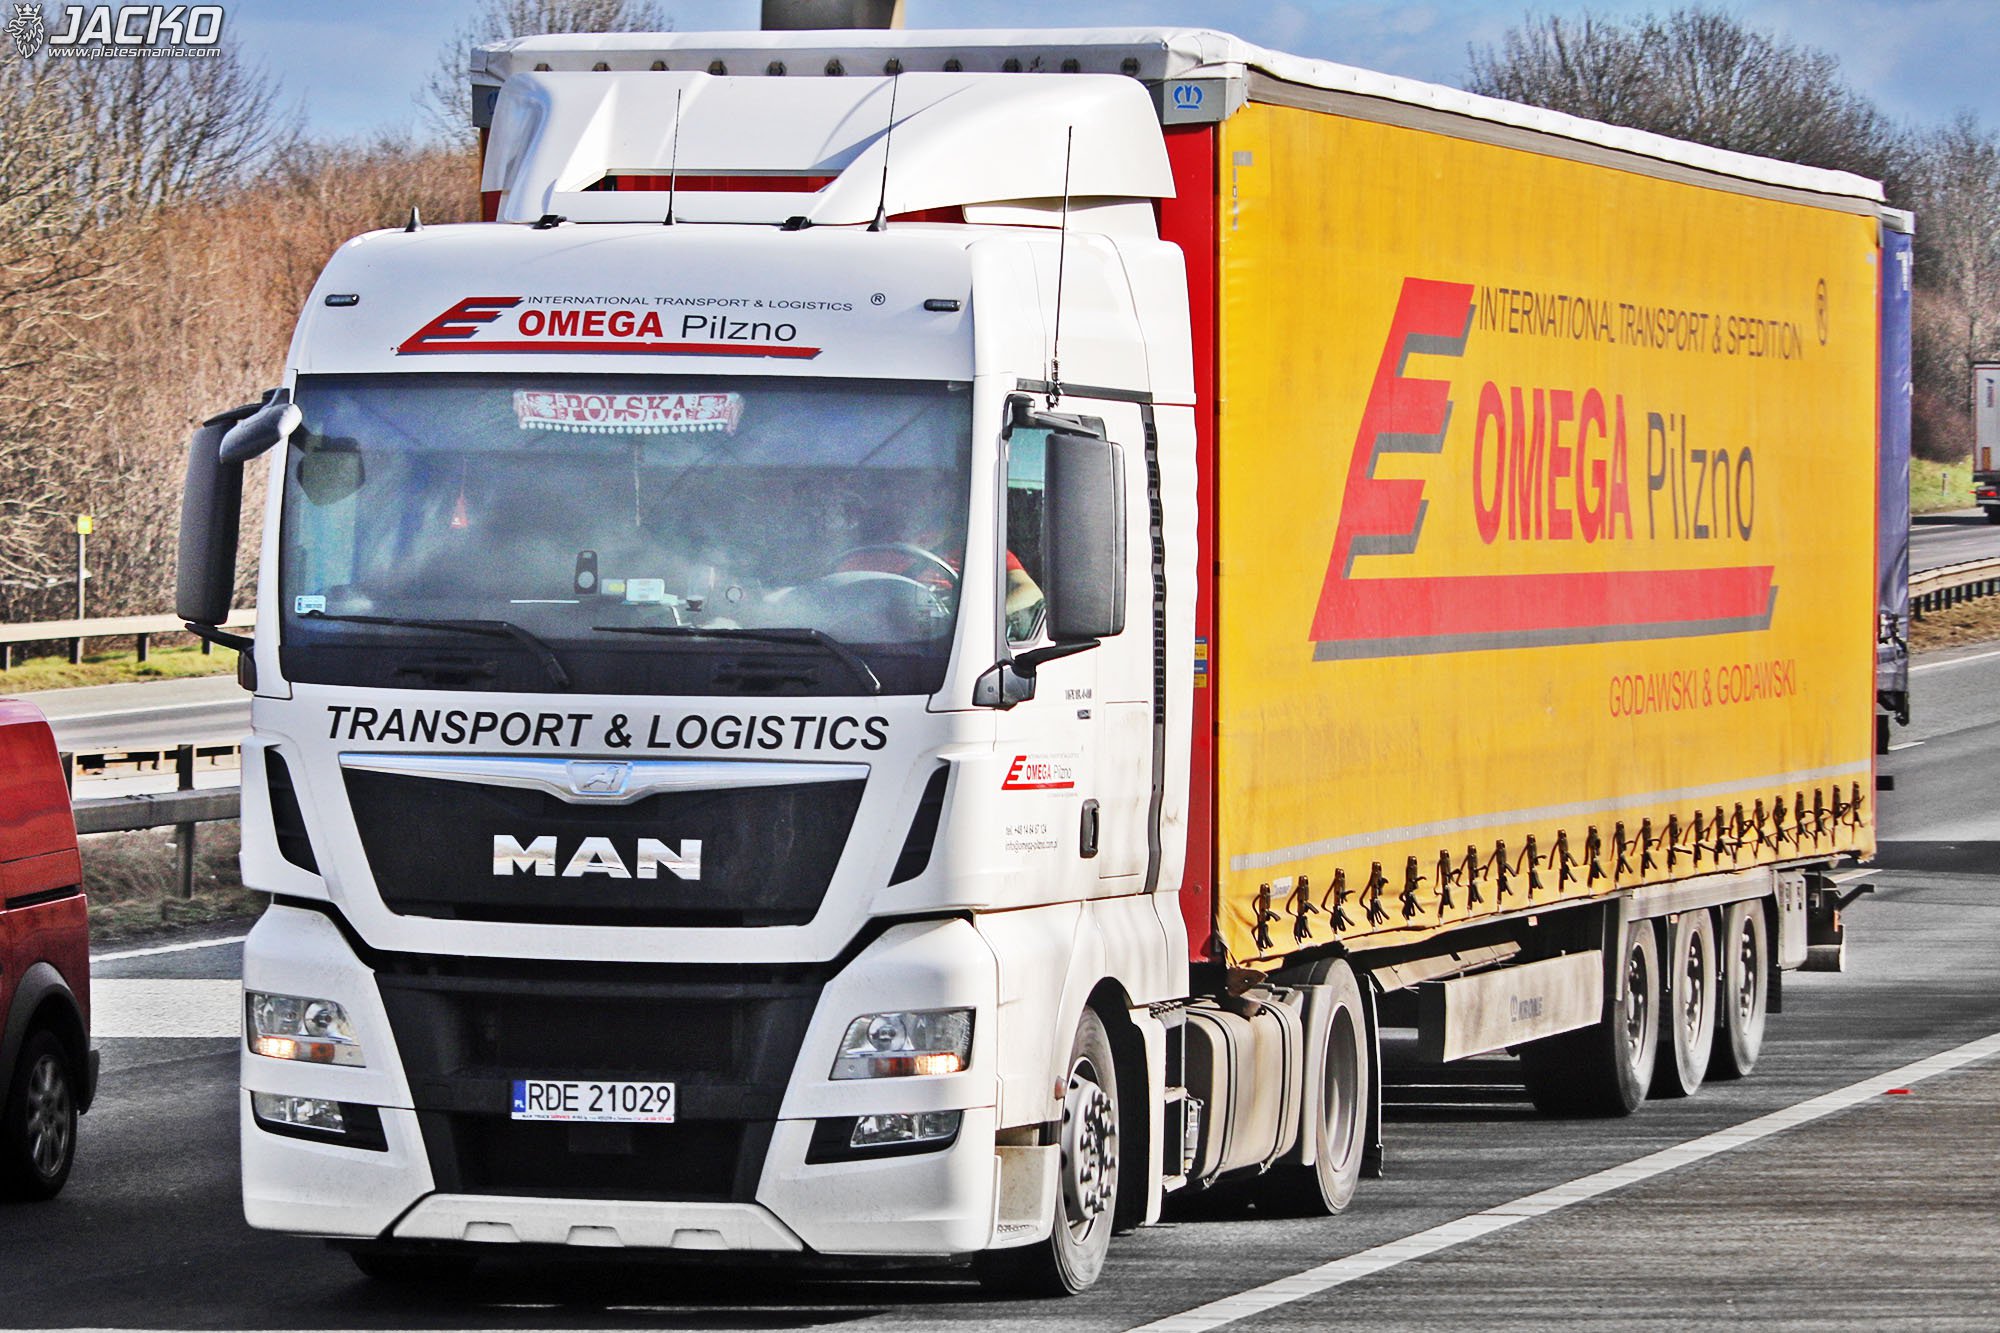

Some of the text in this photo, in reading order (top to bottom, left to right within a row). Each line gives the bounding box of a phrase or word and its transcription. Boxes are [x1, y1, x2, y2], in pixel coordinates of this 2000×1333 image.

[528, 296, 649, 307] INTERNATIONAL
[654, 297, 749, 309] TRANSPORT
[753, 299, 763, 309] &
[768, 300, 853, 312] LOGISTICS
[518, 310, 797, 342] OMEGA Pilzno
[1479, 286, 1615, 343] INTERNATIONAL
[1619, 303, 1709, 352] TRANSPORT
[1711, 315, 1721, 354] &
[1727, 315, 1803, 360] SPEDITION
[565, 394, 688, 427] POLSKA
[1473, 380, 1754, 545] OMEGA Pilzno
[1609, 659, 1797, 718] GODAWSKI & GODAWSKI
[326, 705, 890, 750] TRANSPORT & LOGISTICS
[1026, 764, 1051, 780] OMEGA
[493, 834, 702, 880] MAN
[514, 1099, 525, 1108] PL
[528, 1082, 671, 1113] RDE 21029
